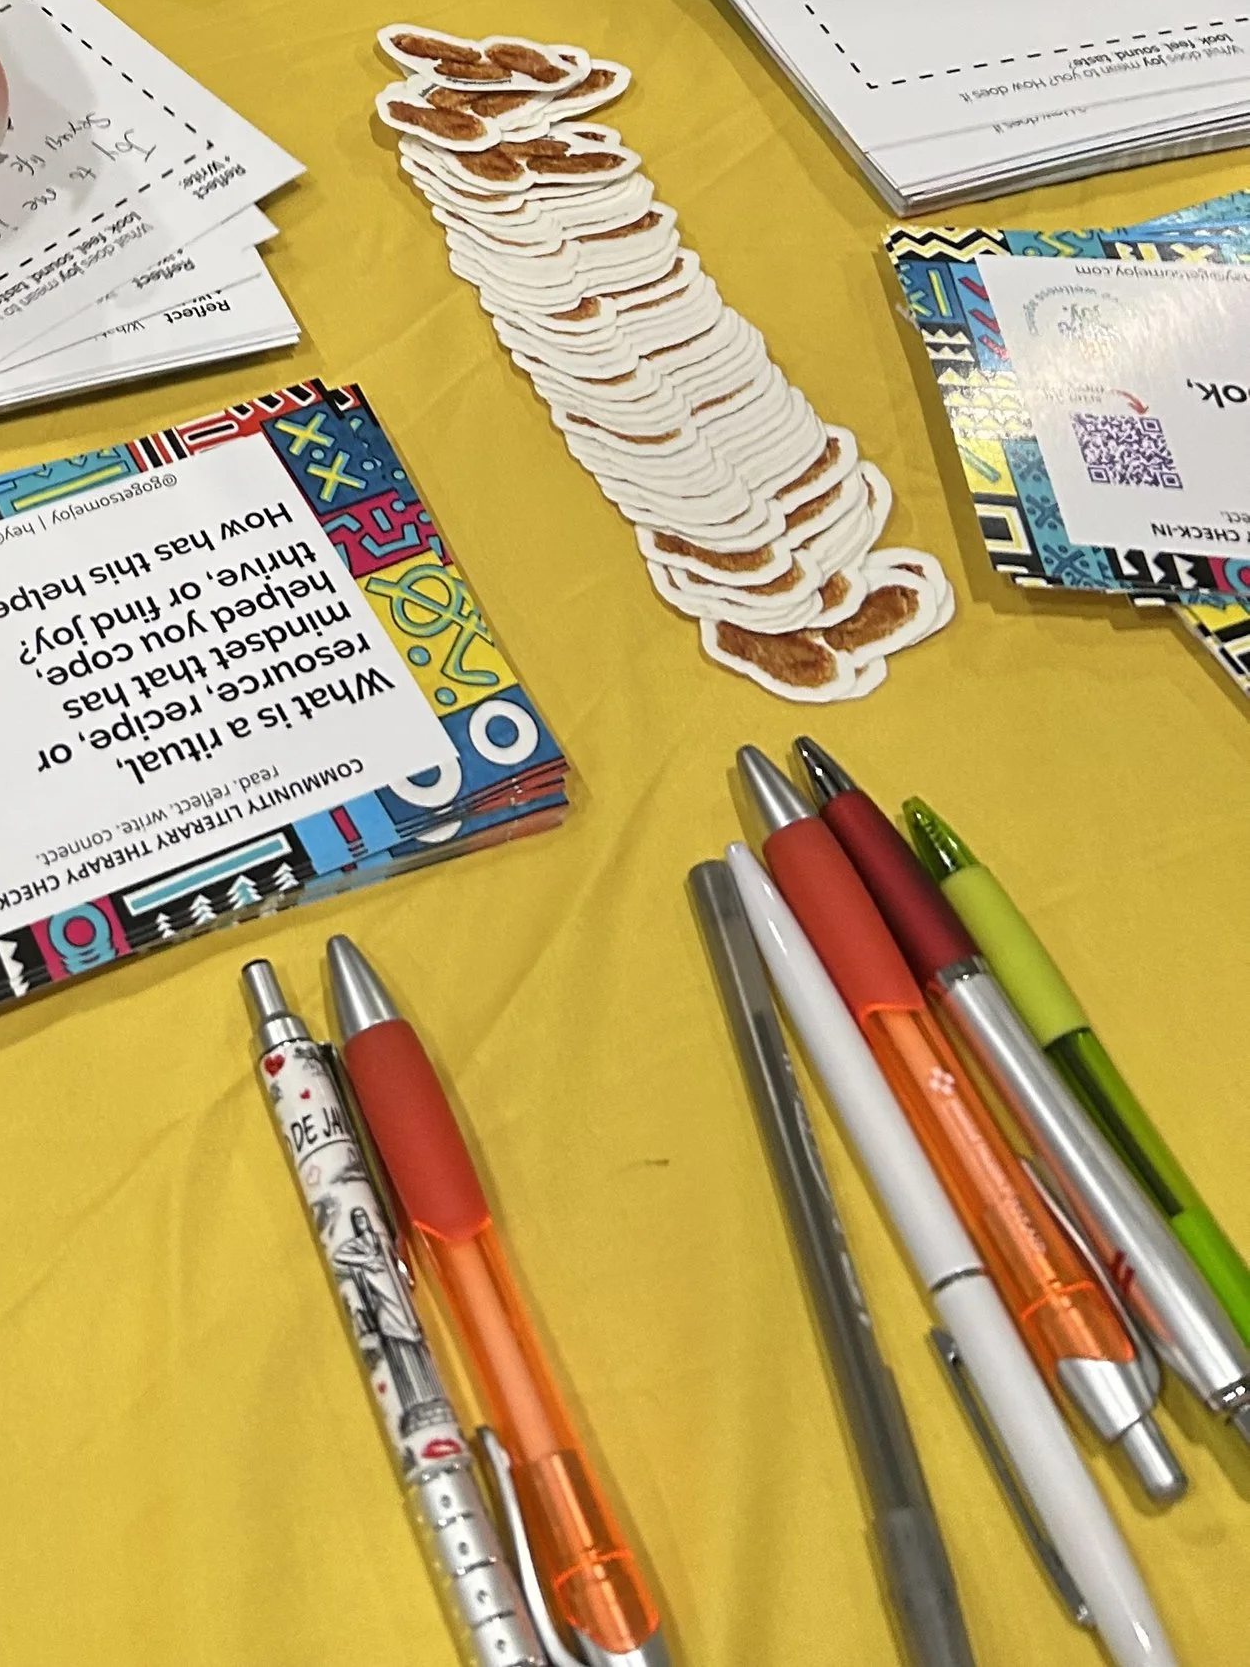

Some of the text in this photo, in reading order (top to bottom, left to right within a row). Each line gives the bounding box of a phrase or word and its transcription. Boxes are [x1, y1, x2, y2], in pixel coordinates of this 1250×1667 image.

[1048, 67, 1082, 86] you?
[1082, 68, 1101, 78] to
[1142, 54, 1167, 67] joy
[958, 92, 972, 102] it
[971, 85, 1009, 99] does
[1011, 77, 1047, 92] How
[90, 128, 157, 163] Joy
[80, 243, 115, 268] does
[58, 261, 85, 283] joy
[18, 278, 60, 306] mean
[2, 303, 22, 316] to
[163, 300, 231, 324] Reflect
[1187, 379, 1250, 408] ok,
[52, 473, 177, 524] @gogetsomejoy
[220, 502, 293, 540] How
[1150, 522, 1240, 543] CHECK-IN
[154, 530, 215, 561] has
[88, 552, 151, 585] this
[19, 541, 316, 665] thrive, or find joy?
[36, 570, 336, 686] helped you cope,
[62, 600, 351, 719] mindset that has
[38, 632, 371, 772] resource, recipe, or
[116, 667, 395, 784] What is a ritual,
[247, 758, 363, 815] COMMUNITY
[36, 765, 279, 866] read. reflect. write. connect.
[156, 804, 243, 850] LITERARY
[66, 840, 153, 885] THERAPY
[290, 1114, 318, 1153] DE
